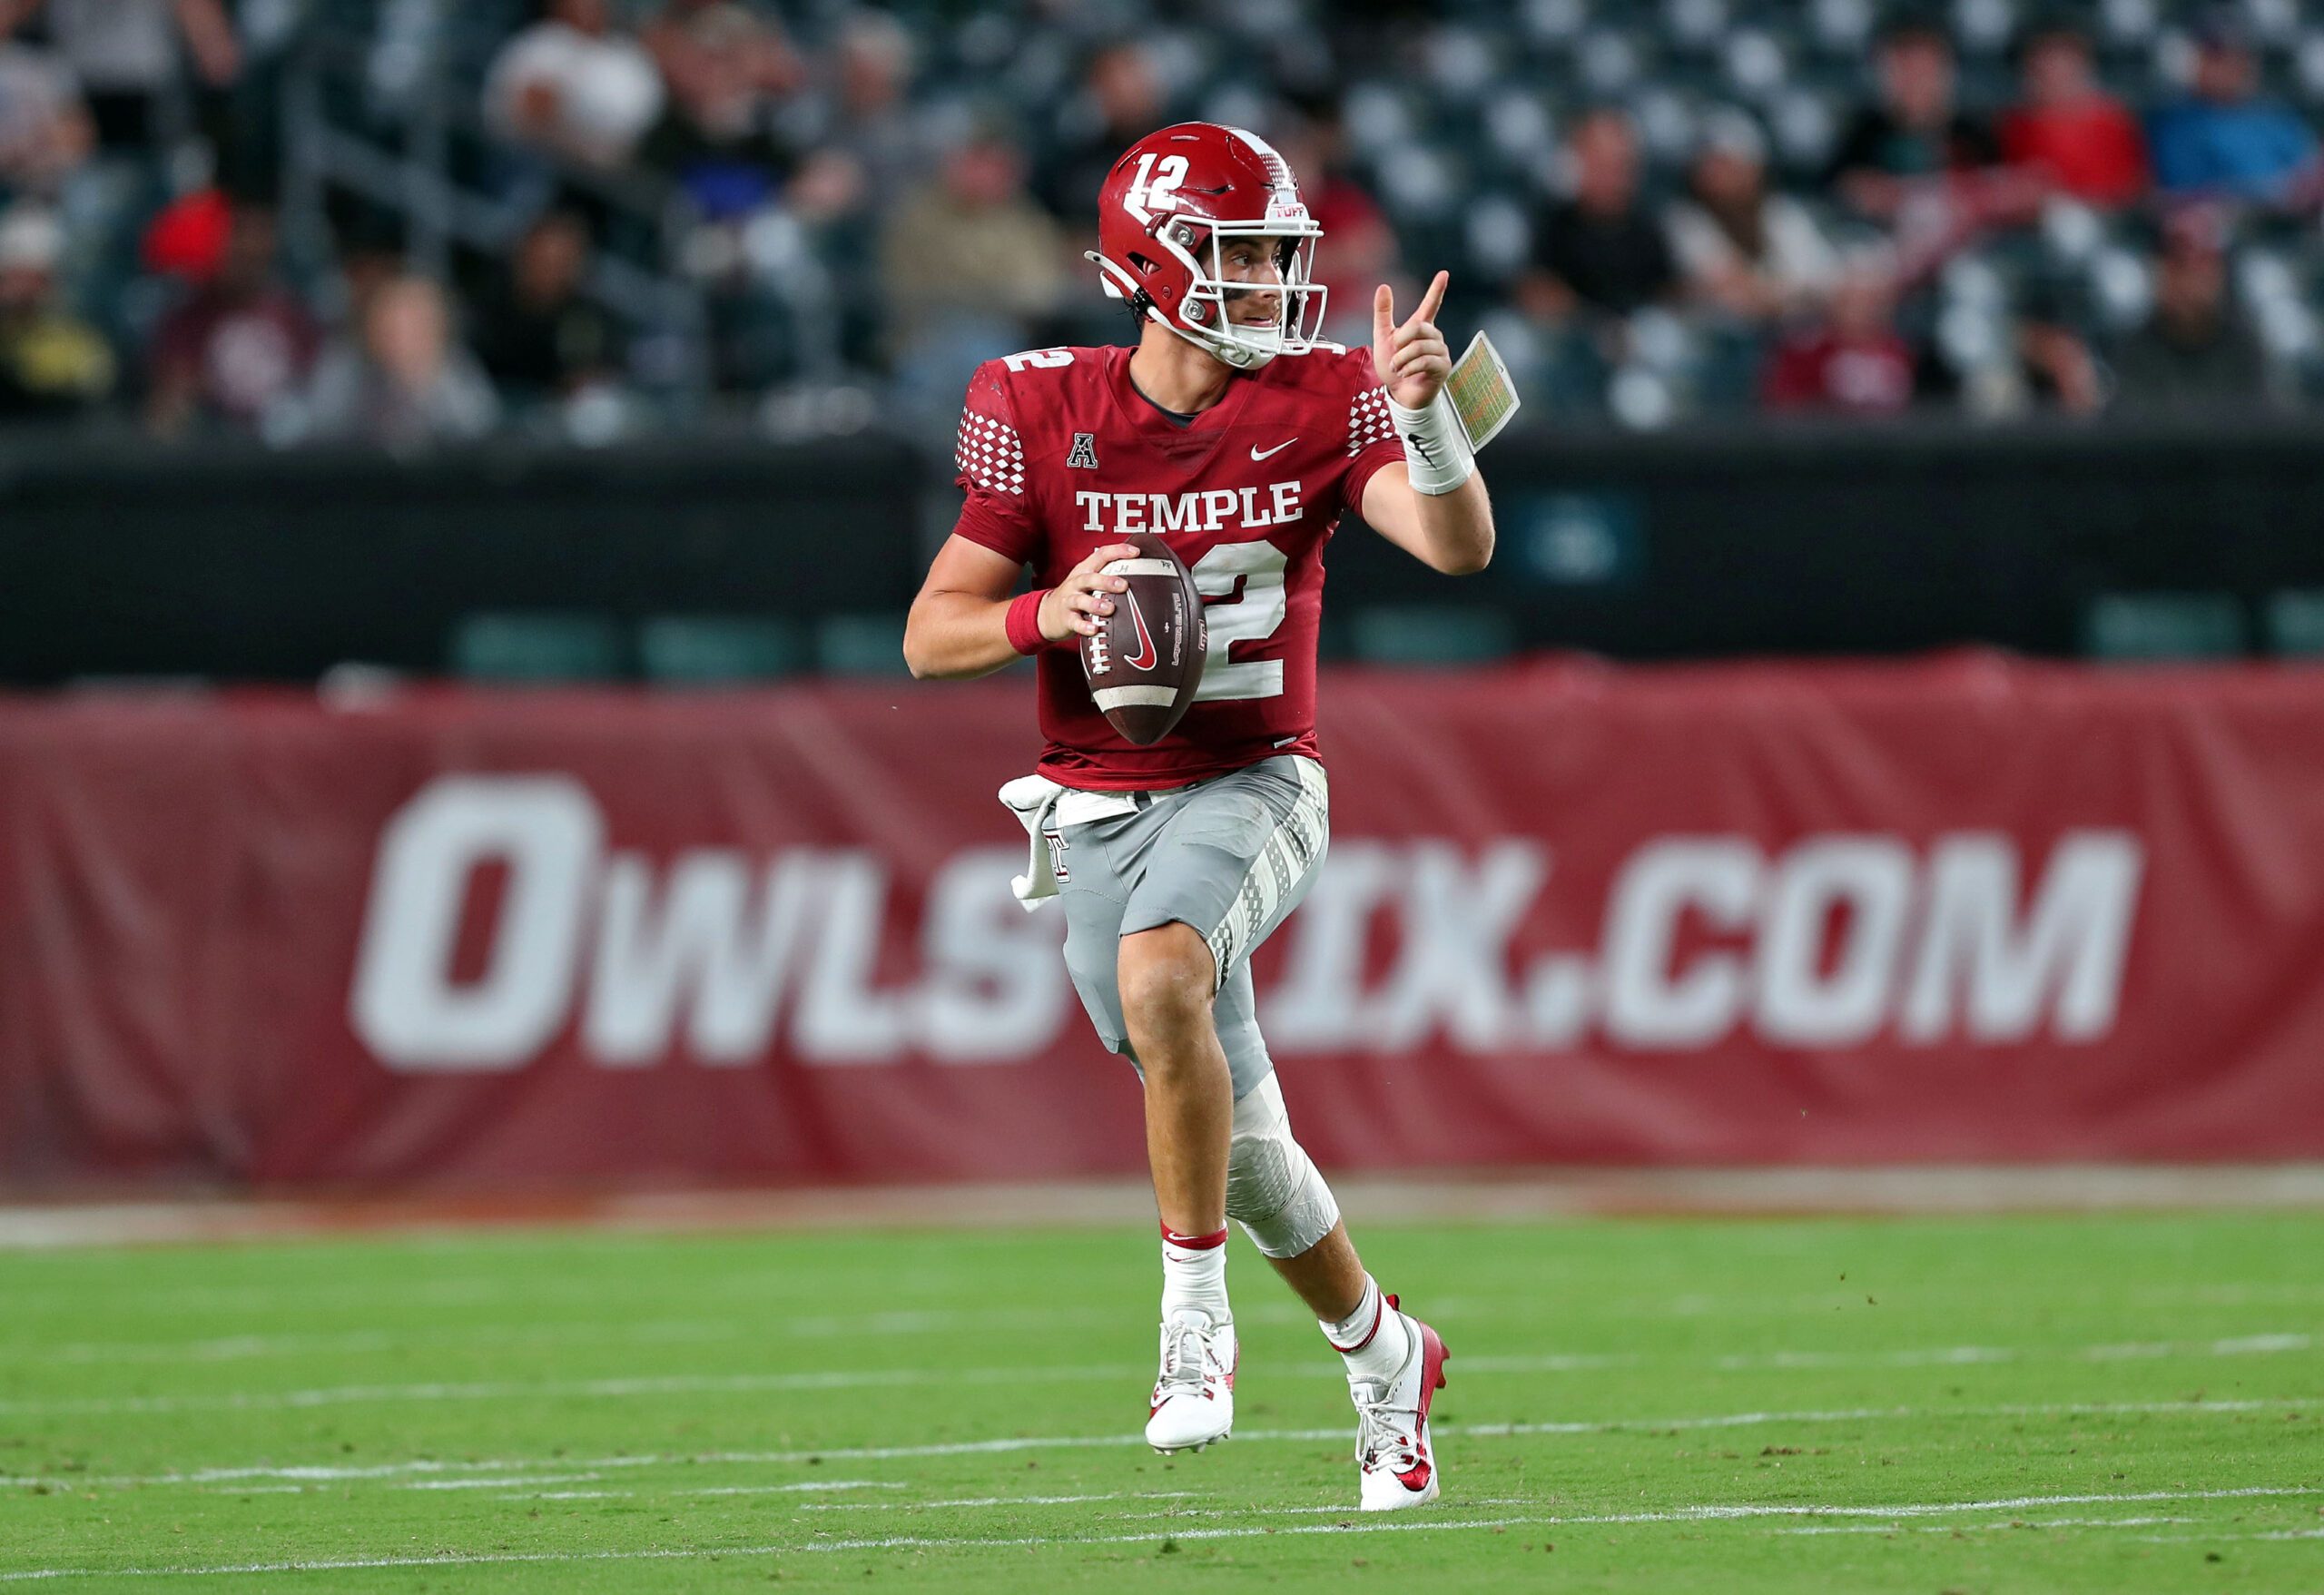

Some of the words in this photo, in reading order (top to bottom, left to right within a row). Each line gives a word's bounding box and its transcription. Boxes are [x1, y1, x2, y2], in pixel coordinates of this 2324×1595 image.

[1123, 153, 1189, 211] 12
[1076, 480, 1304, 534] TEMPLE
[1191, 539, 1288, 702] 2
